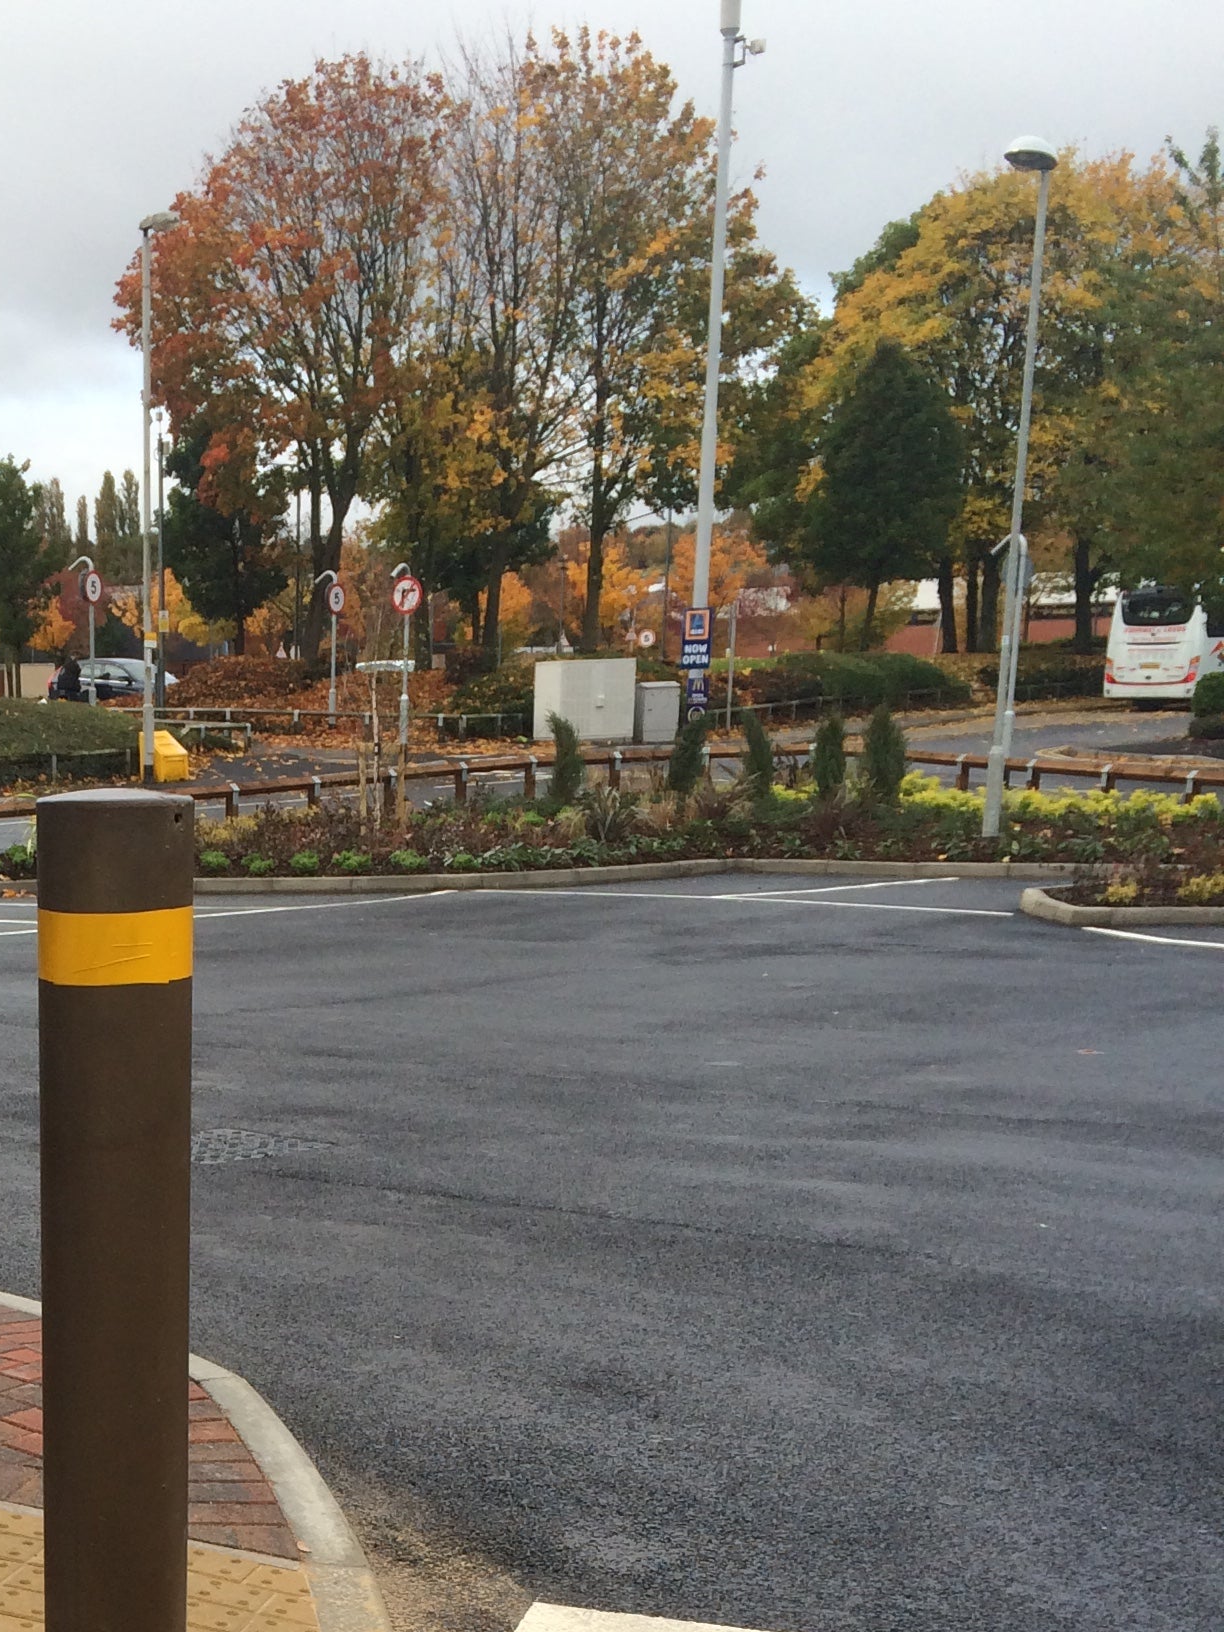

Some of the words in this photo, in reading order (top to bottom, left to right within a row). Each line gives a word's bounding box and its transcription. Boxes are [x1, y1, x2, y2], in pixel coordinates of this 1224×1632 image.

[91, 580, 97, 595] 5
[334, 592, 341, 605] 5
[684, 643, 708, 654] NOW
[682, 654, 709, 665] OPEN
